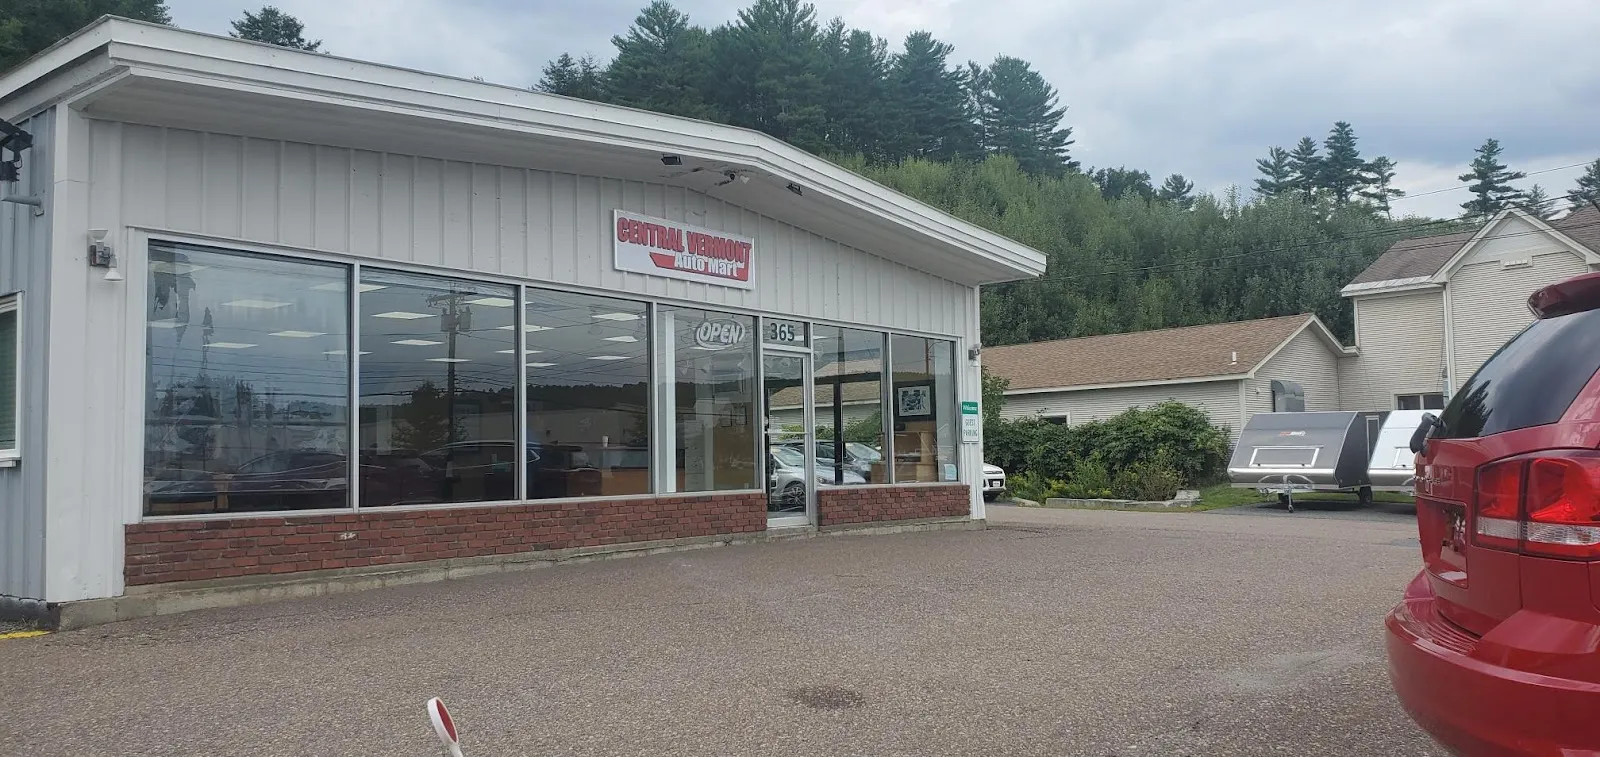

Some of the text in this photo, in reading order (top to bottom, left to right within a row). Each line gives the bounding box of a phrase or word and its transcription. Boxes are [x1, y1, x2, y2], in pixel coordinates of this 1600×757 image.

[616, 217, 752, 264] CENTRAL VERMONT
[674, 252, 738, 278] Auto Mart
[700, 321, 740, 344] OPEN
[770, 322, 795, 342] 365
